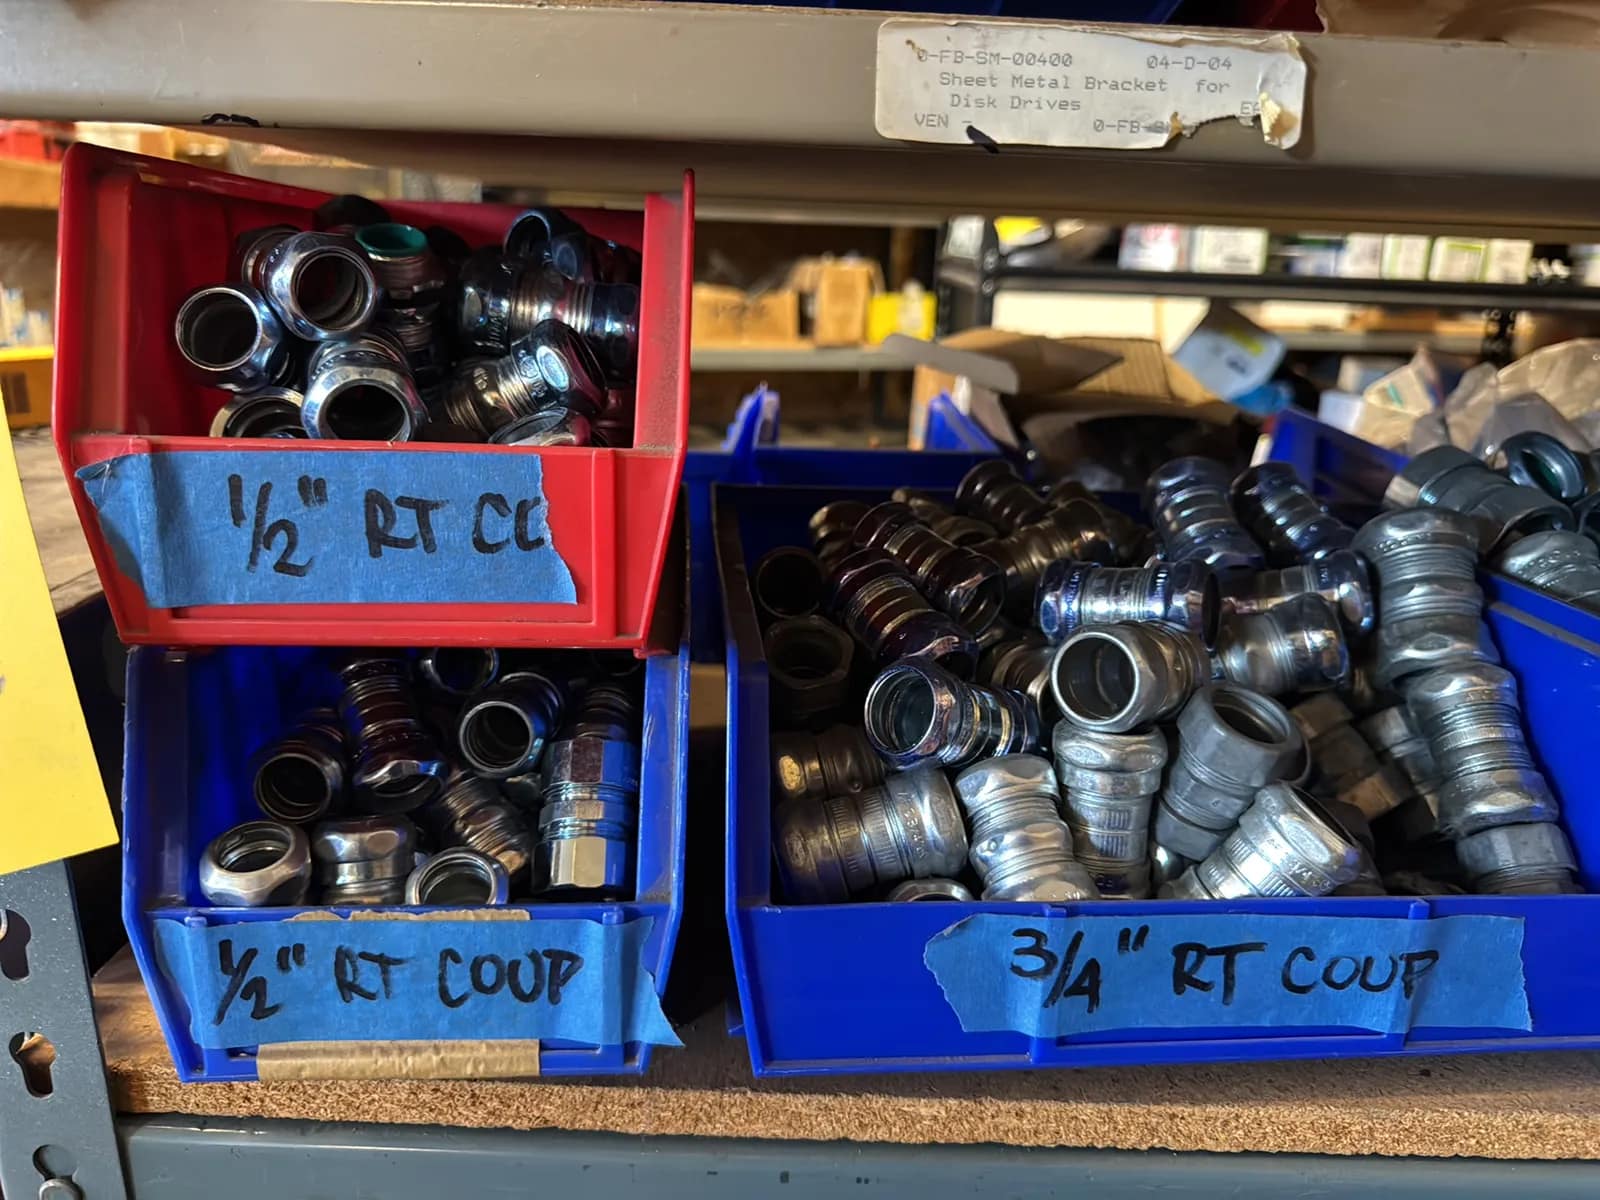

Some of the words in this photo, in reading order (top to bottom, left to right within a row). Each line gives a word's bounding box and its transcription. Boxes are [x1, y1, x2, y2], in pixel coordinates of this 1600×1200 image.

[916, 49, 1073, 68] 0-FB-SM-00400
[1146, 55, 1232, 71] 04-D-04
[938, 72, 999, 88] Sheet
[1011, 74, 1071, 90] Metal
[1084, 76, 1168, 92] Bracket
[1196, 79, 1231, 93] for
[950, 94, 998, 109] Disk
[1010, 95, 1081, 111] Drives
[914, 112, 949, 128] VEN
[227, 473, 330, 578] 1/2"
[363, 487, 446, 559] RT
[1009, 924, 1150, 1014] 3/4"
[1171, 941, 1268, 1006] RT
[1280, 946, 1441, 1001] COUP
[213, 938, 306, 1027] 1/2"
[333, 944, 414, 1004] RT
[437, 947, 585, 1009] COUP
